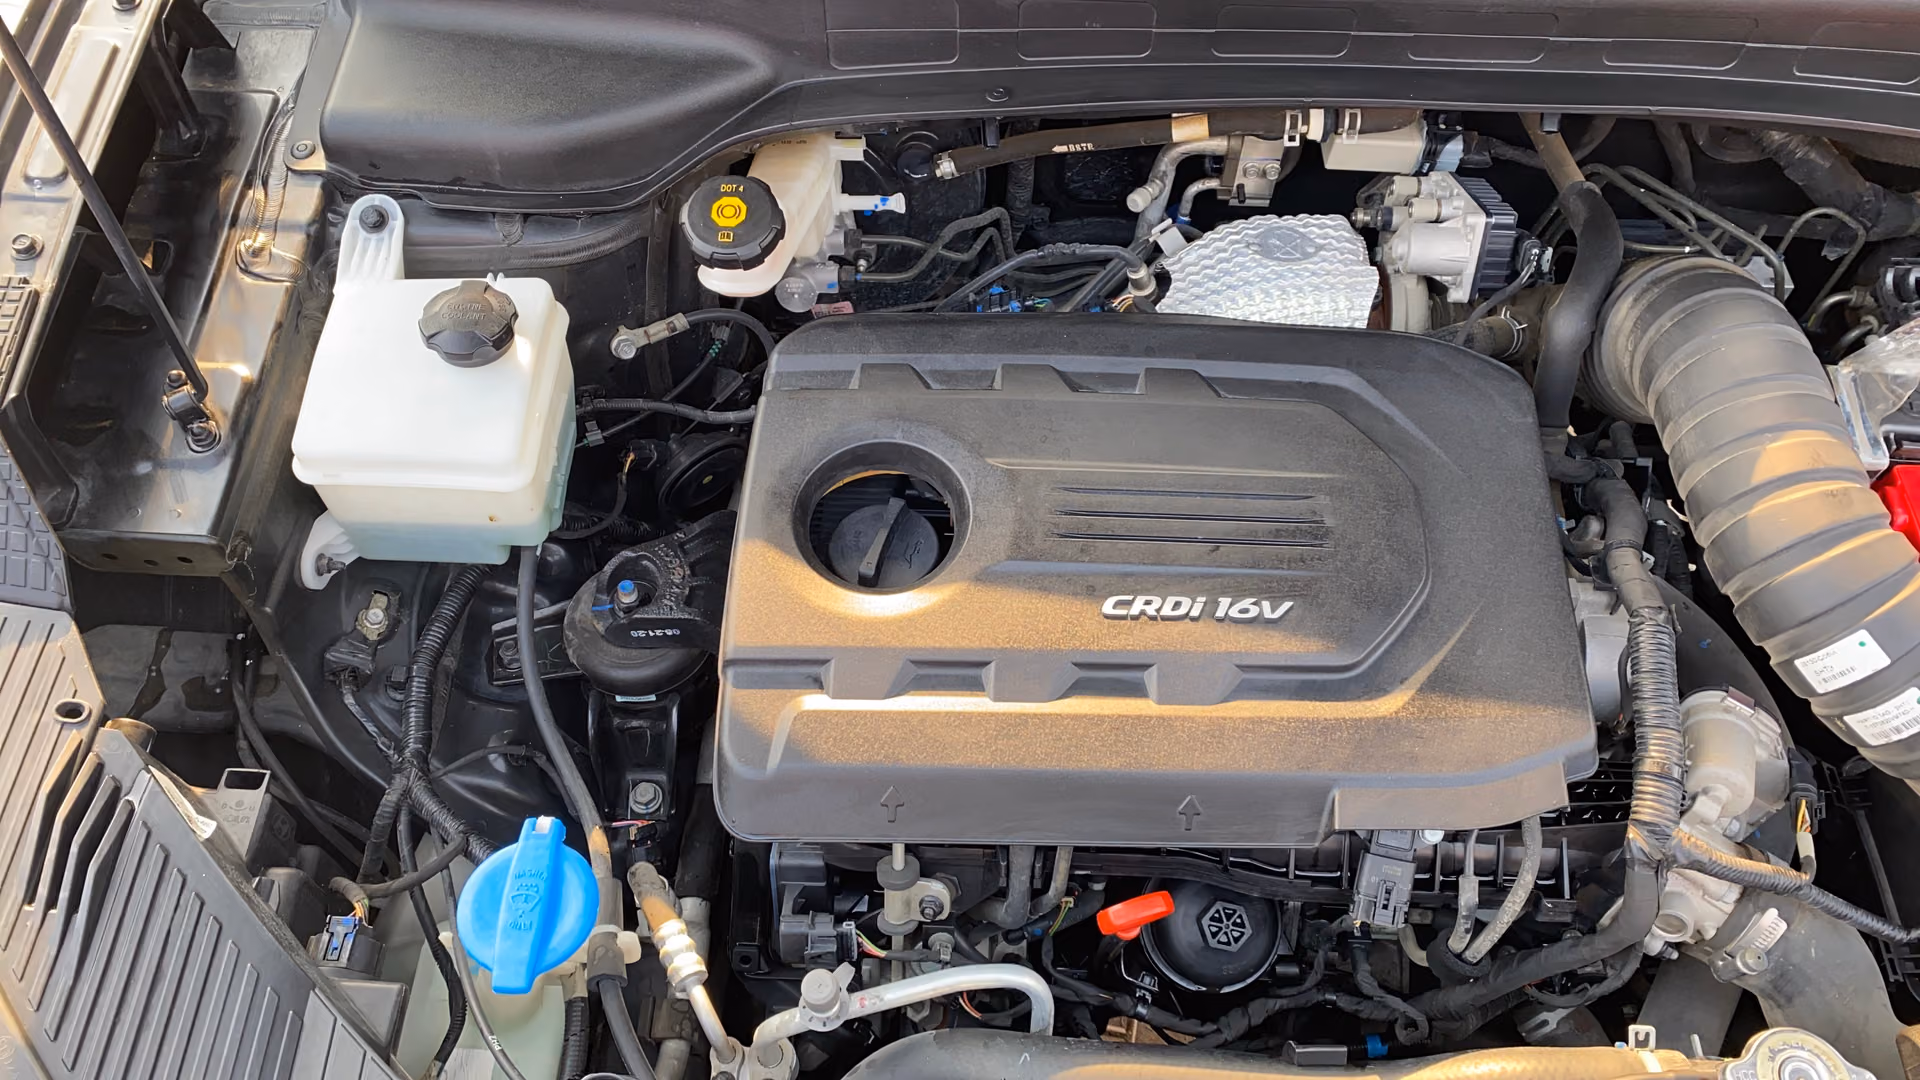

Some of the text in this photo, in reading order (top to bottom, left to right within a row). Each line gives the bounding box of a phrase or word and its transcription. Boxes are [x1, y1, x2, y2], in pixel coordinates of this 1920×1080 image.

[720, 184, 737, 192] DOT
[441, 312, 486, 320] COOLANT
[1102, 595, 1294, 623] CRDi 16V
